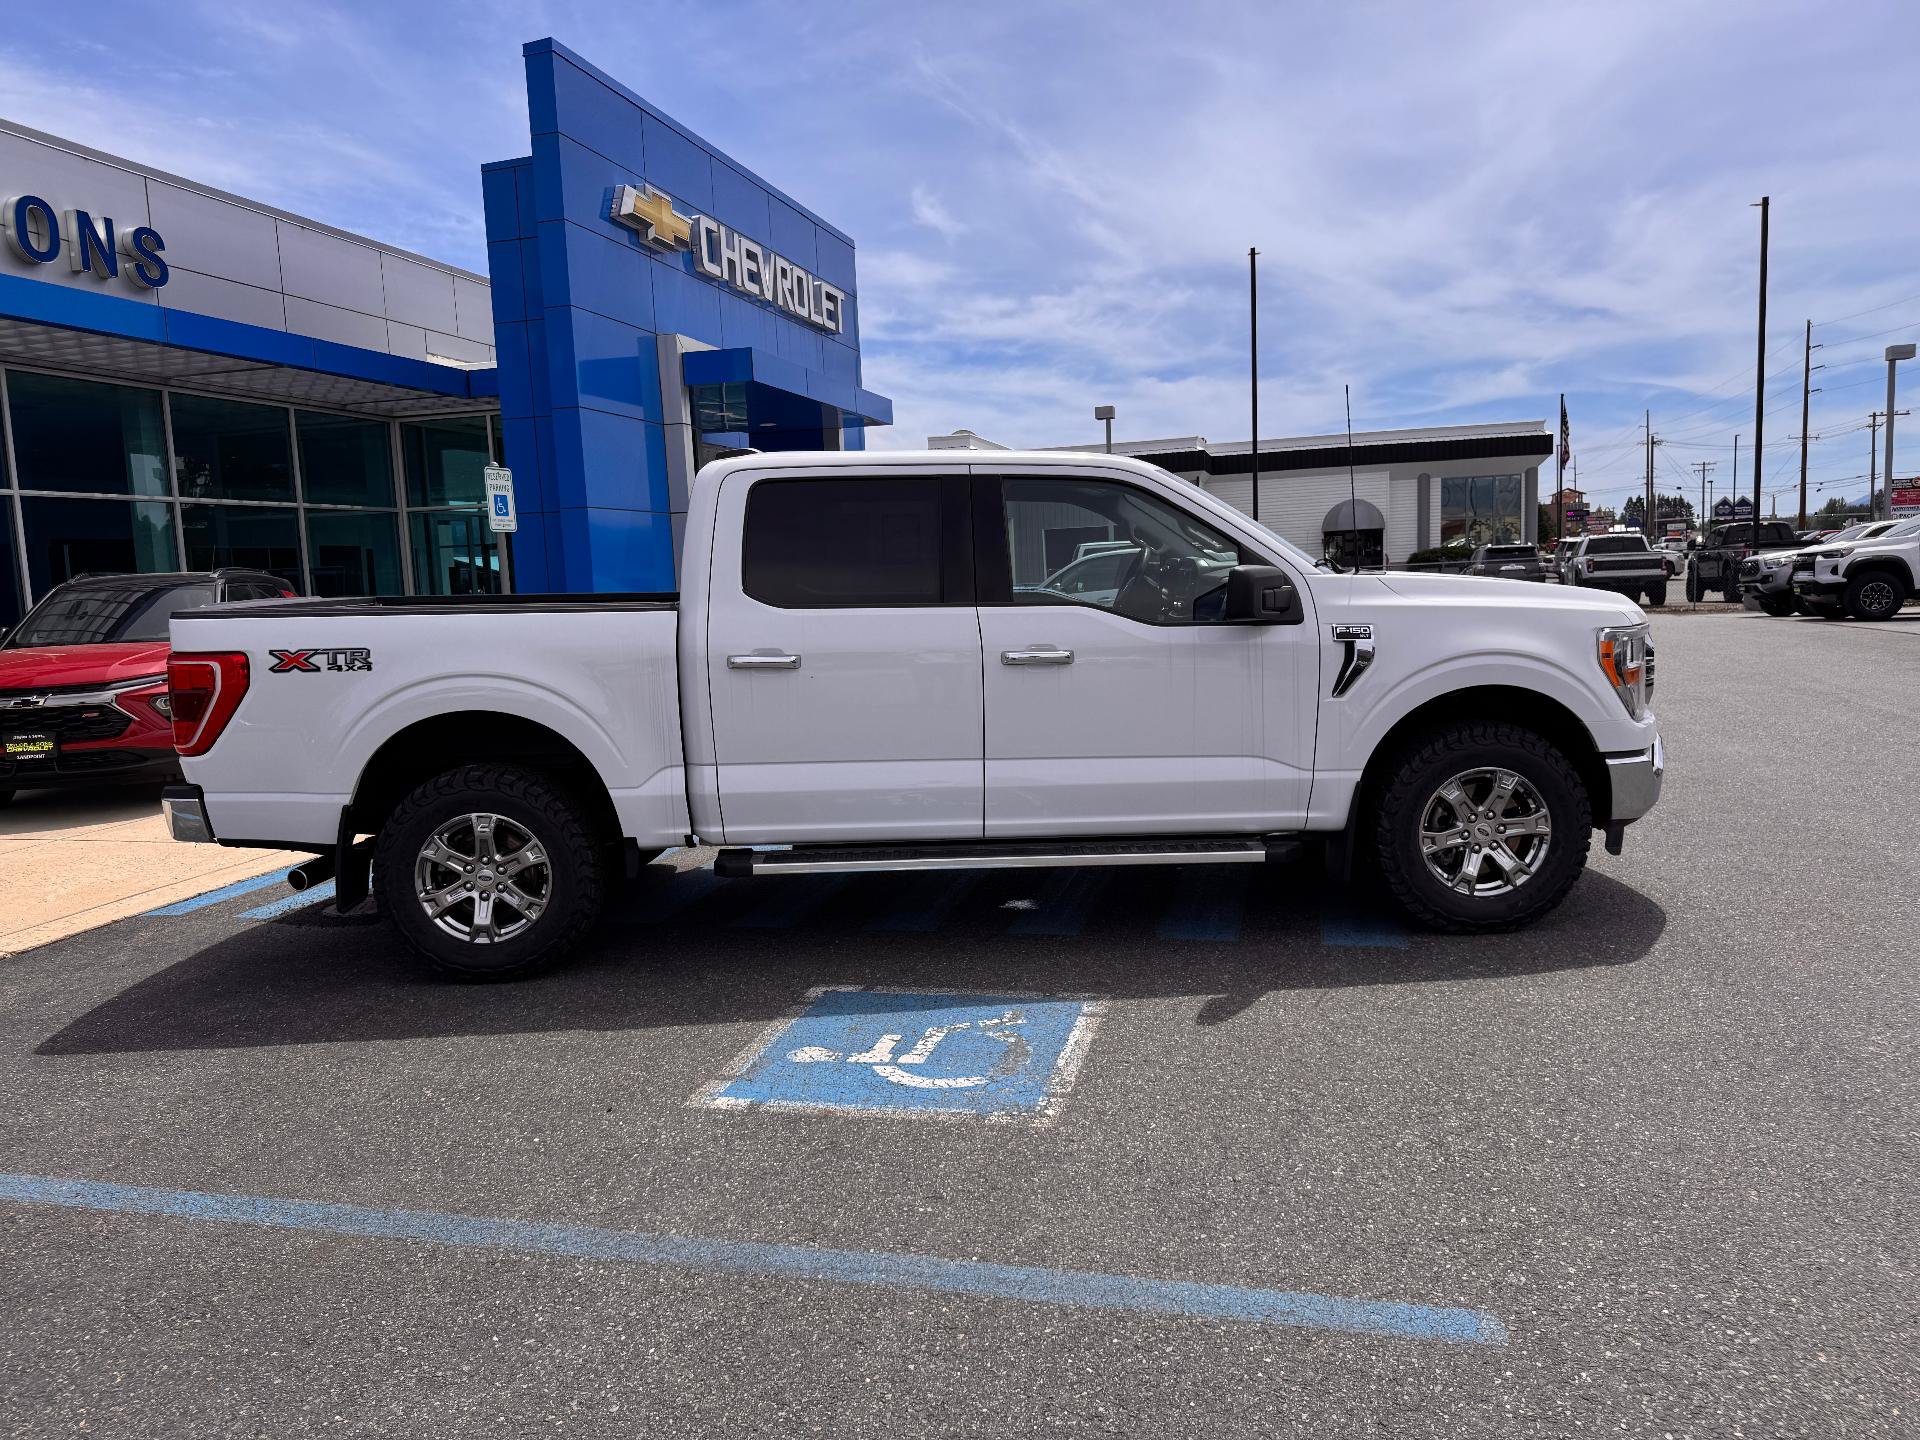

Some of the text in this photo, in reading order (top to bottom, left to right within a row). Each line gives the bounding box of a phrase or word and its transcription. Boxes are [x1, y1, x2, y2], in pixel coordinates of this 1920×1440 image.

[5, 195, 169, 288] ONS
[693, 214, 845, 334] CHEVROLET
[487, 472, 510, 481] RESERVED
[489, 483, 510, 492] PARKING
